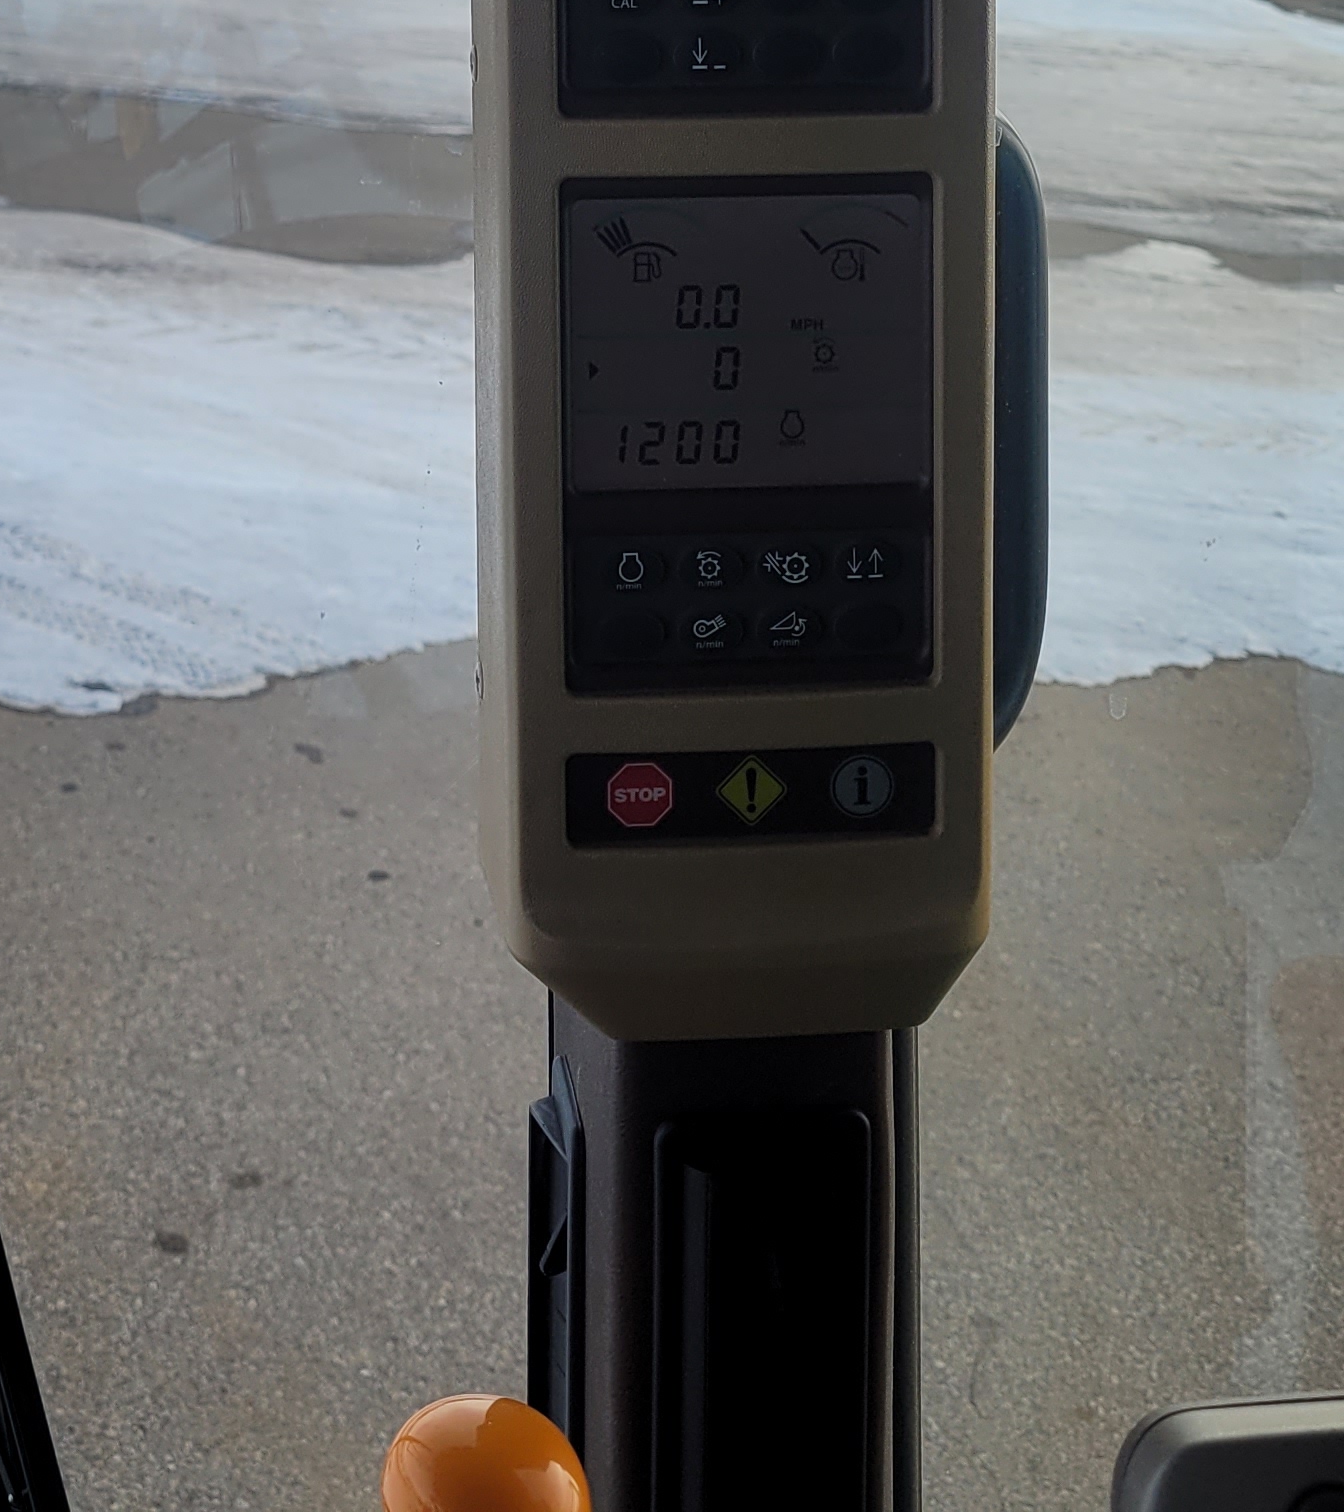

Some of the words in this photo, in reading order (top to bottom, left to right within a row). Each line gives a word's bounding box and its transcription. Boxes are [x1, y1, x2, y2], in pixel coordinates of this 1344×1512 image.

[676, 285, 741, 329] 0.0
[790, 318, 824, 331] MPH
[713, 346, 741, 390] 0
[618, 419, 741, 465] 1200
[697, 578, 724, 588] n/min
[695, 639, 724, 649] n/min
[773, 637, 800, 648] n/min
[614, 786, 666, 804] STOP
